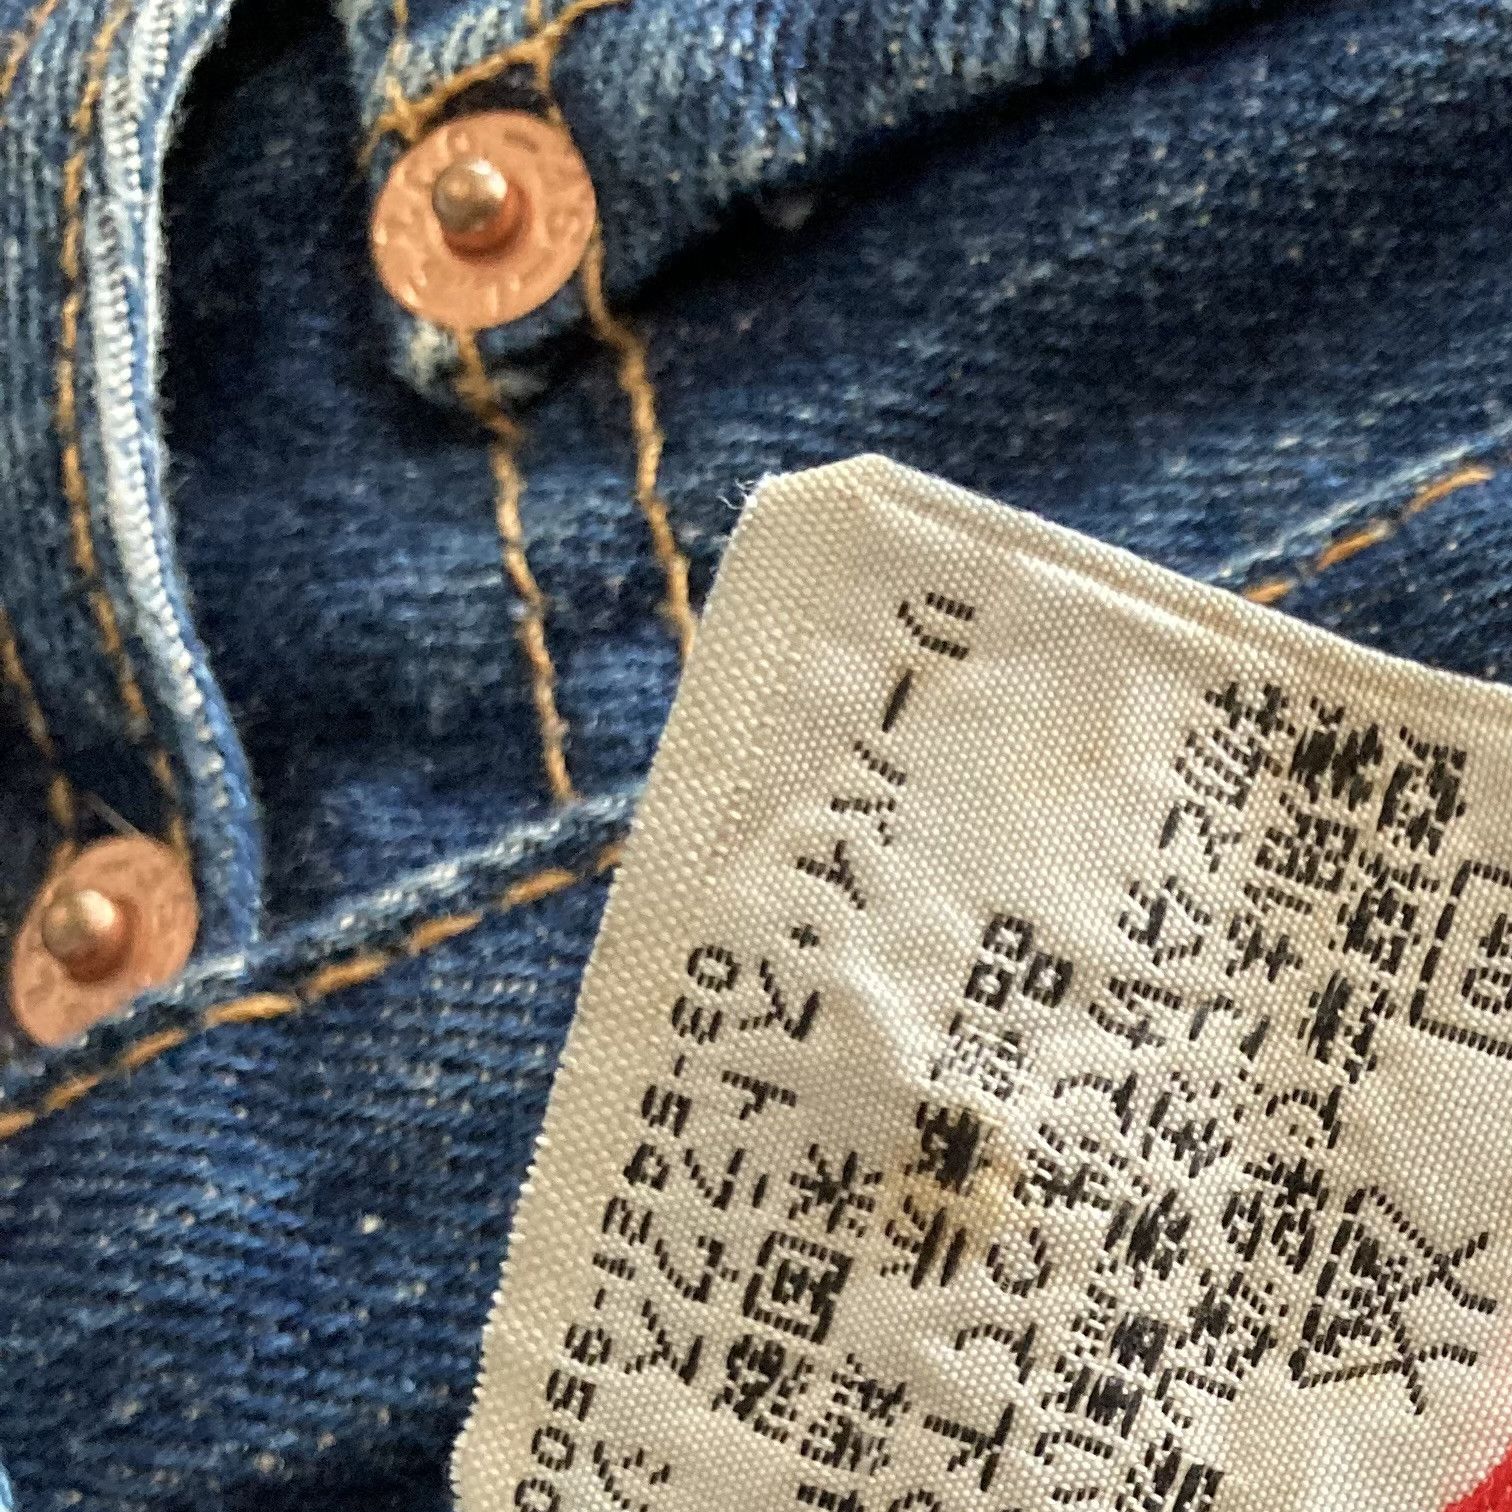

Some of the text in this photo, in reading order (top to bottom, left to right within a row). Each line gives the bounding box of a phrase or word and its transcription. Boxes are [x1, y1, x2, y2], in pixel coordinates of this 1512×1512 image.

[878, 911, 1074, 1291] 品質表示
[709, 1141, 885, 1445] 米国製
